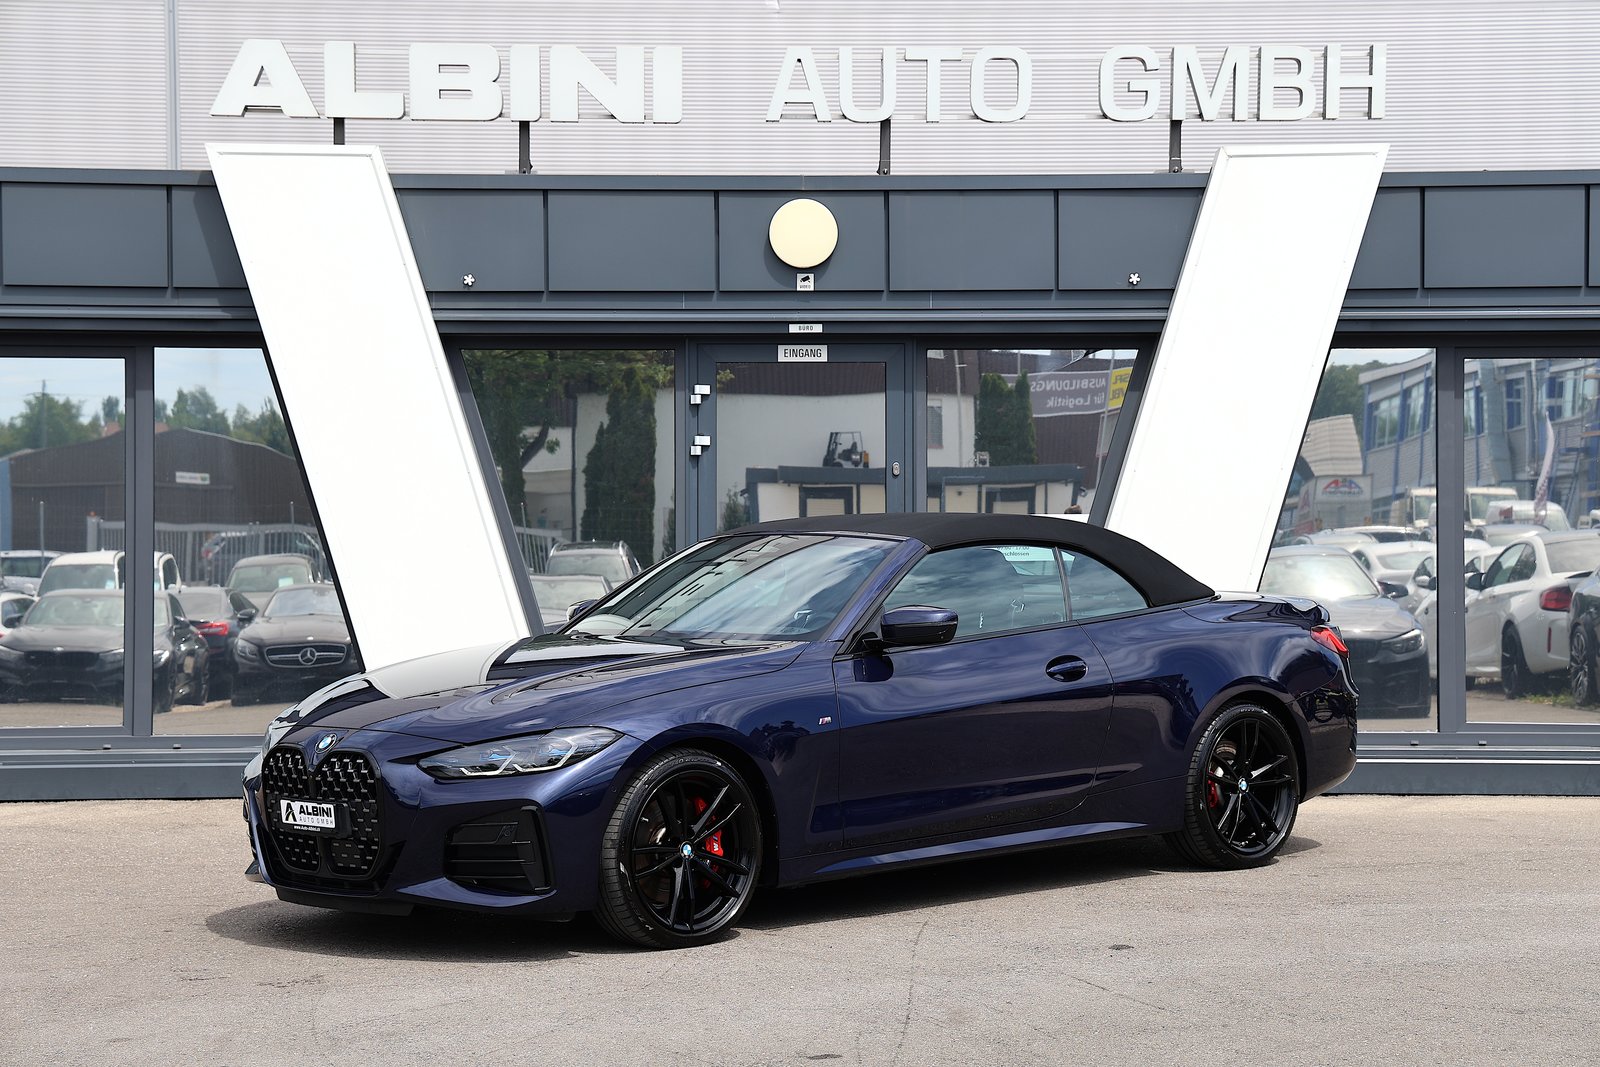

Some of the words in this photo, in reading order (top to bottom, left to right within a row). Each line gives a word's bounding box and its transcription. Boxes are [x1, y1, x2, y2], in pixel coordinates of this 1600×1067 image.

[209, 38, 683, 124] ALBINI
[765, 45, 1033, 123] AUTO
[1098, 43, 1388, 122] GMBH
[783, 348, 822, 358] EINGANG
[299, 804, 332, 818] ALBINI
